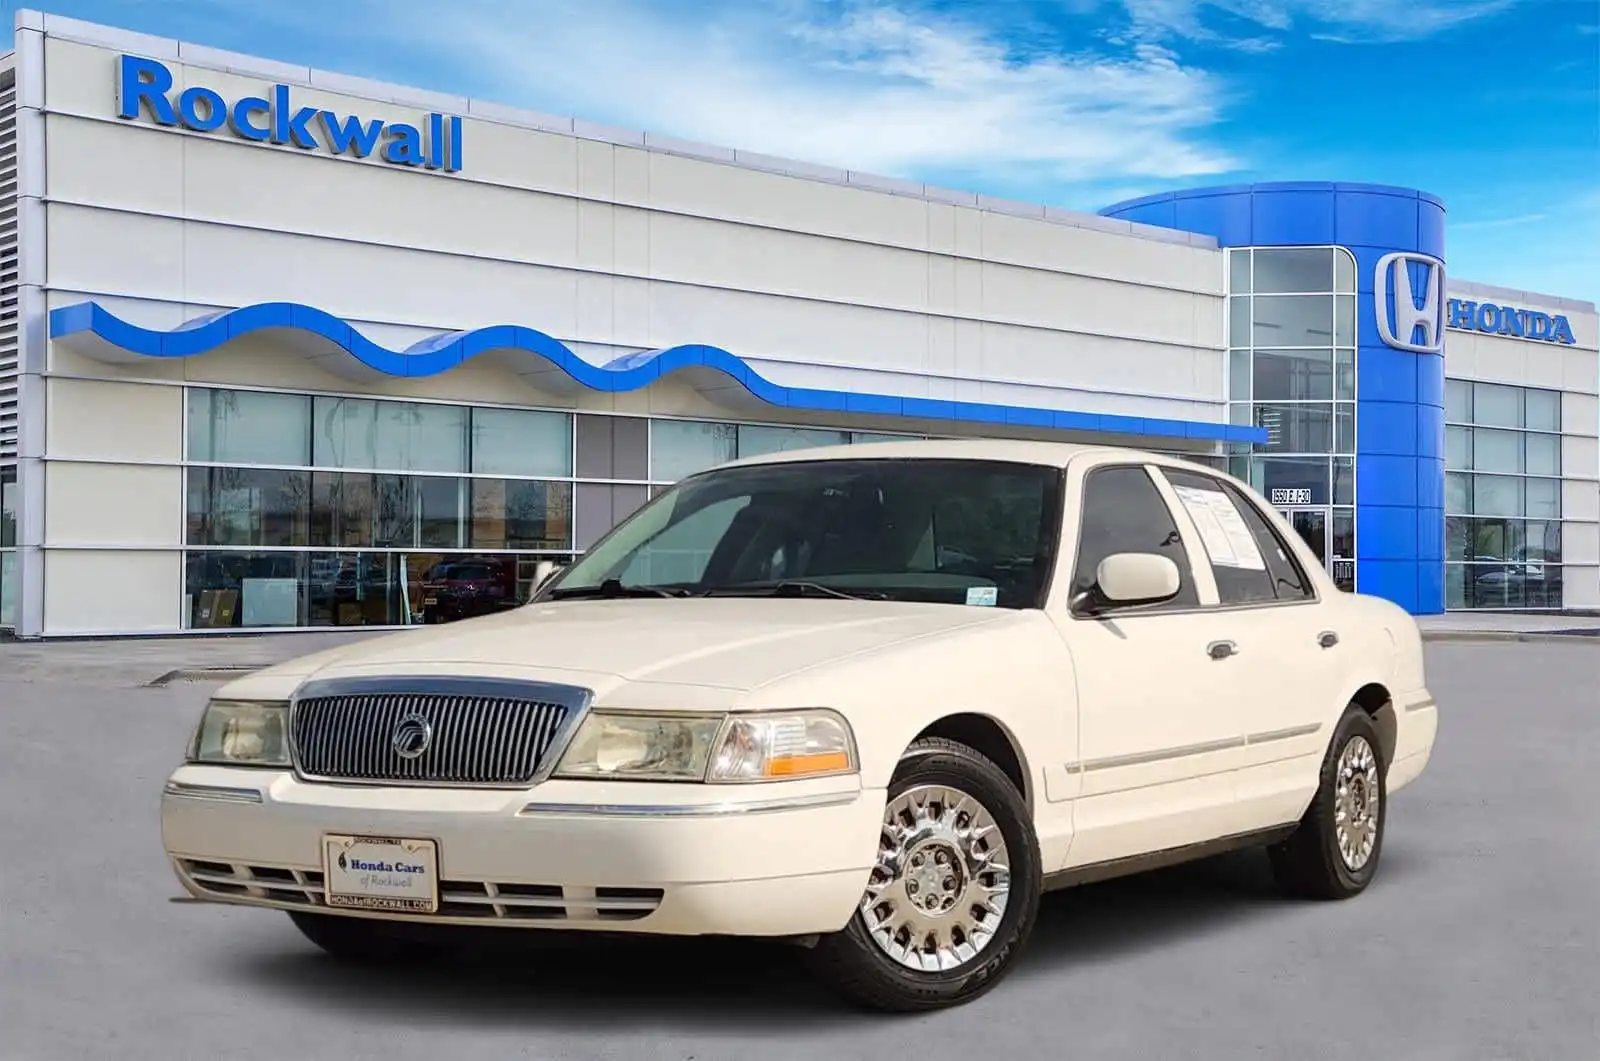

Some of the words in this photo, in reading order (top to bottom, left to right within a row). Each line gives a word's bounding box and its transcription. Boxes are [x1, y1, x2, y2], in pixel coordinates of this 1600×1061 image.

[116, 54, 463, 172] Rockwall
[1448, 298, 1577, 344] HONDA
[351, 859, 393, 872] Honda
[395, 862, 425, 873] Cars
[360, 874, 370, 889] of
